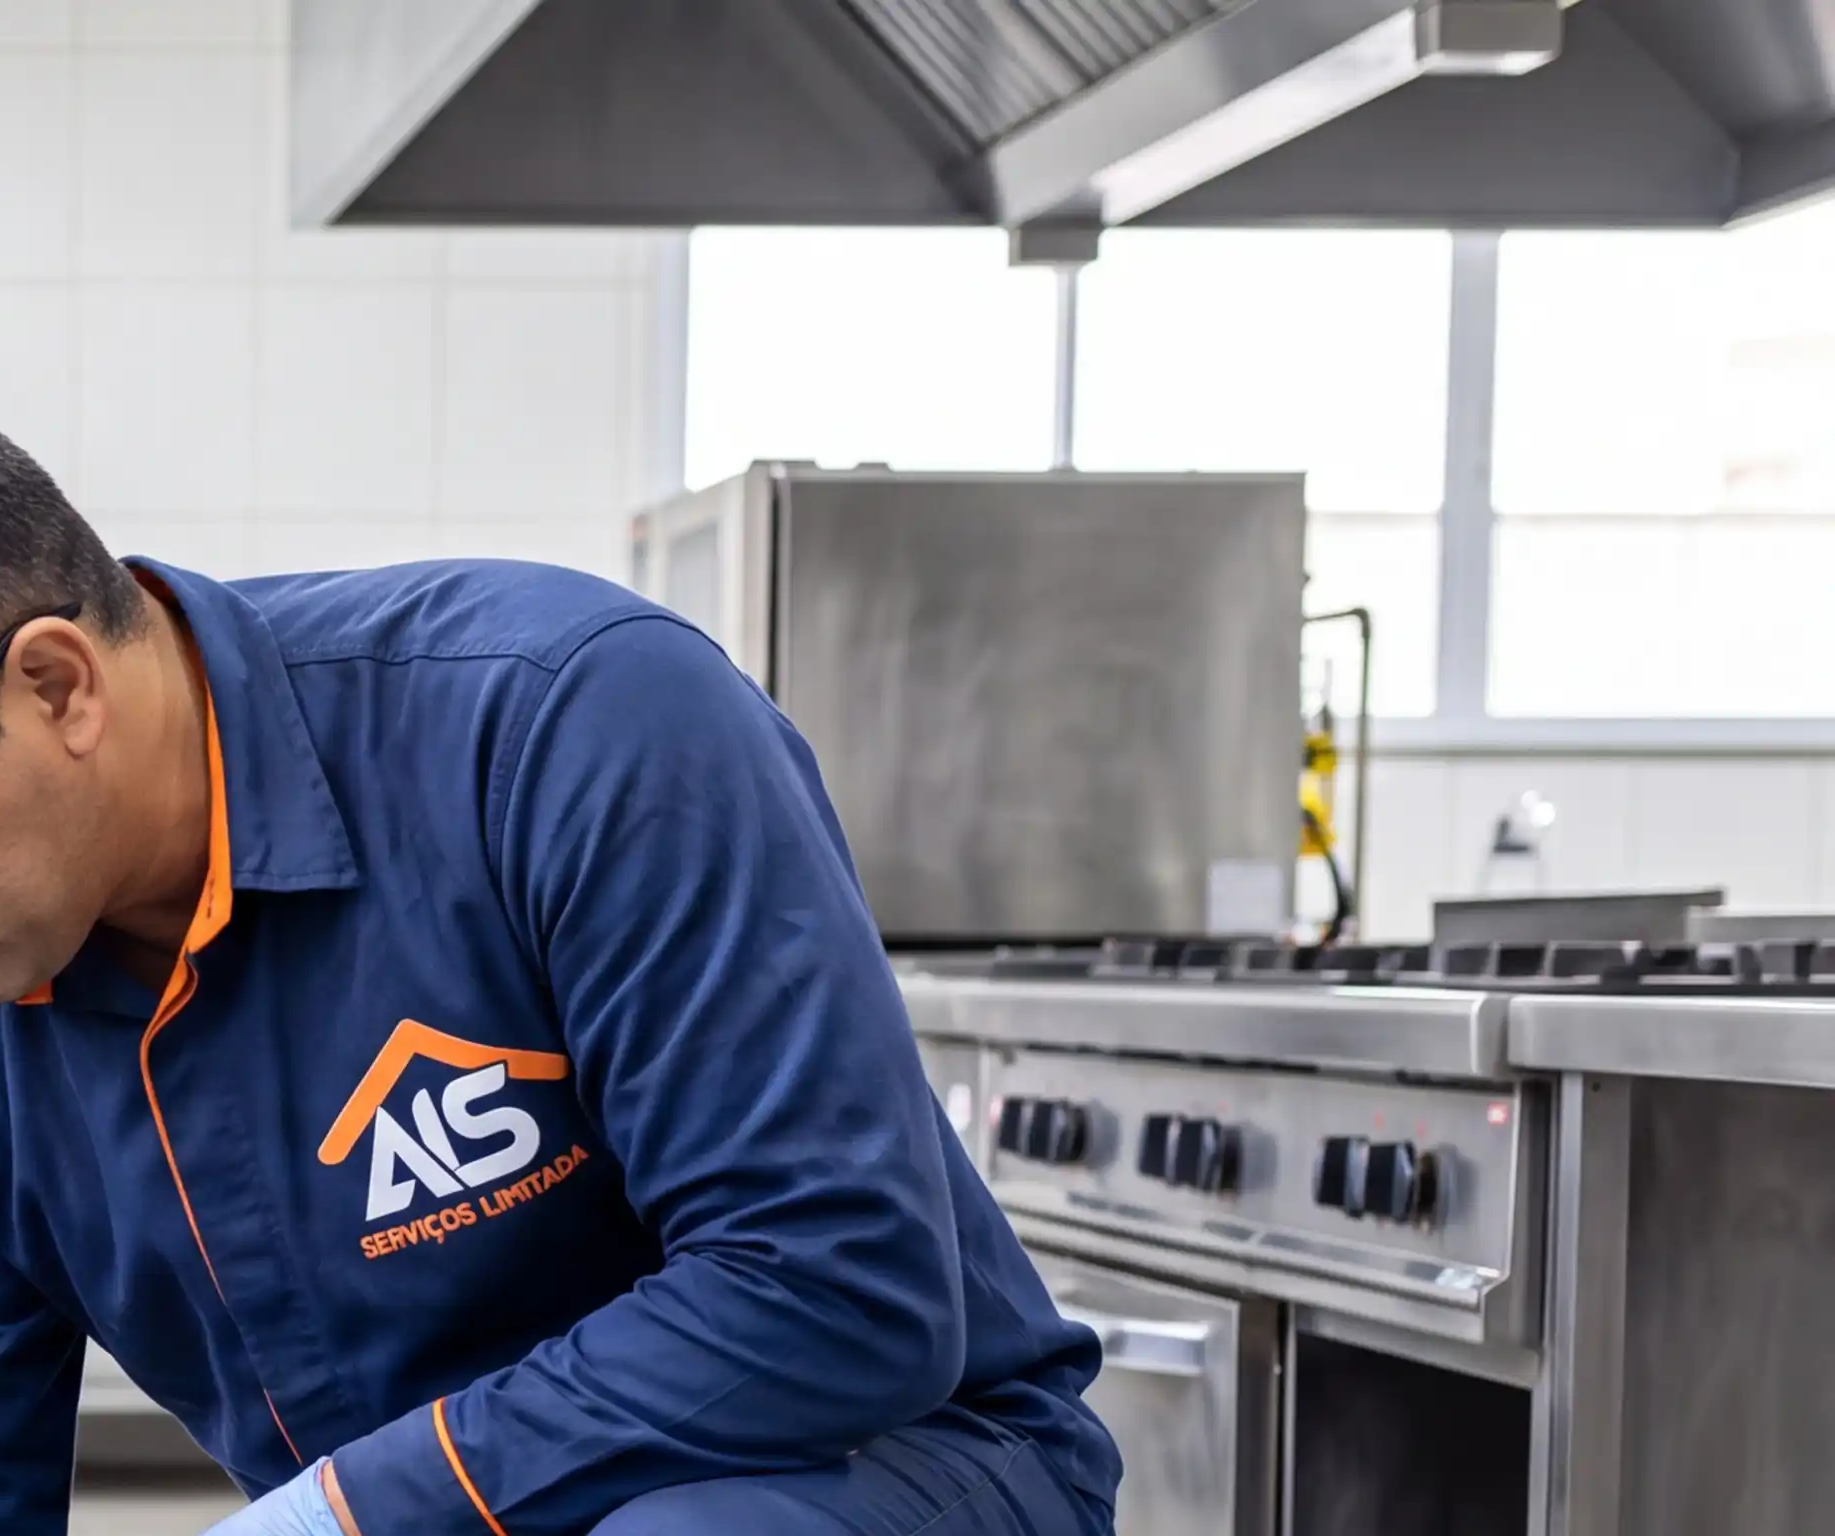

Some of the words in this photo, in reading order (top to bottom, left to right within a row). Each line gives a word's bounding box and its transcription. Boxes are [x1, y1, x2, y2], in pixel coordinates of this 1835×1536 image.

[360, 1202, 477, 1260] SERVIÇOS
[479, 1144, 589, 1219] LIMITADA
[365, 1063, 540, 1222] AIS
